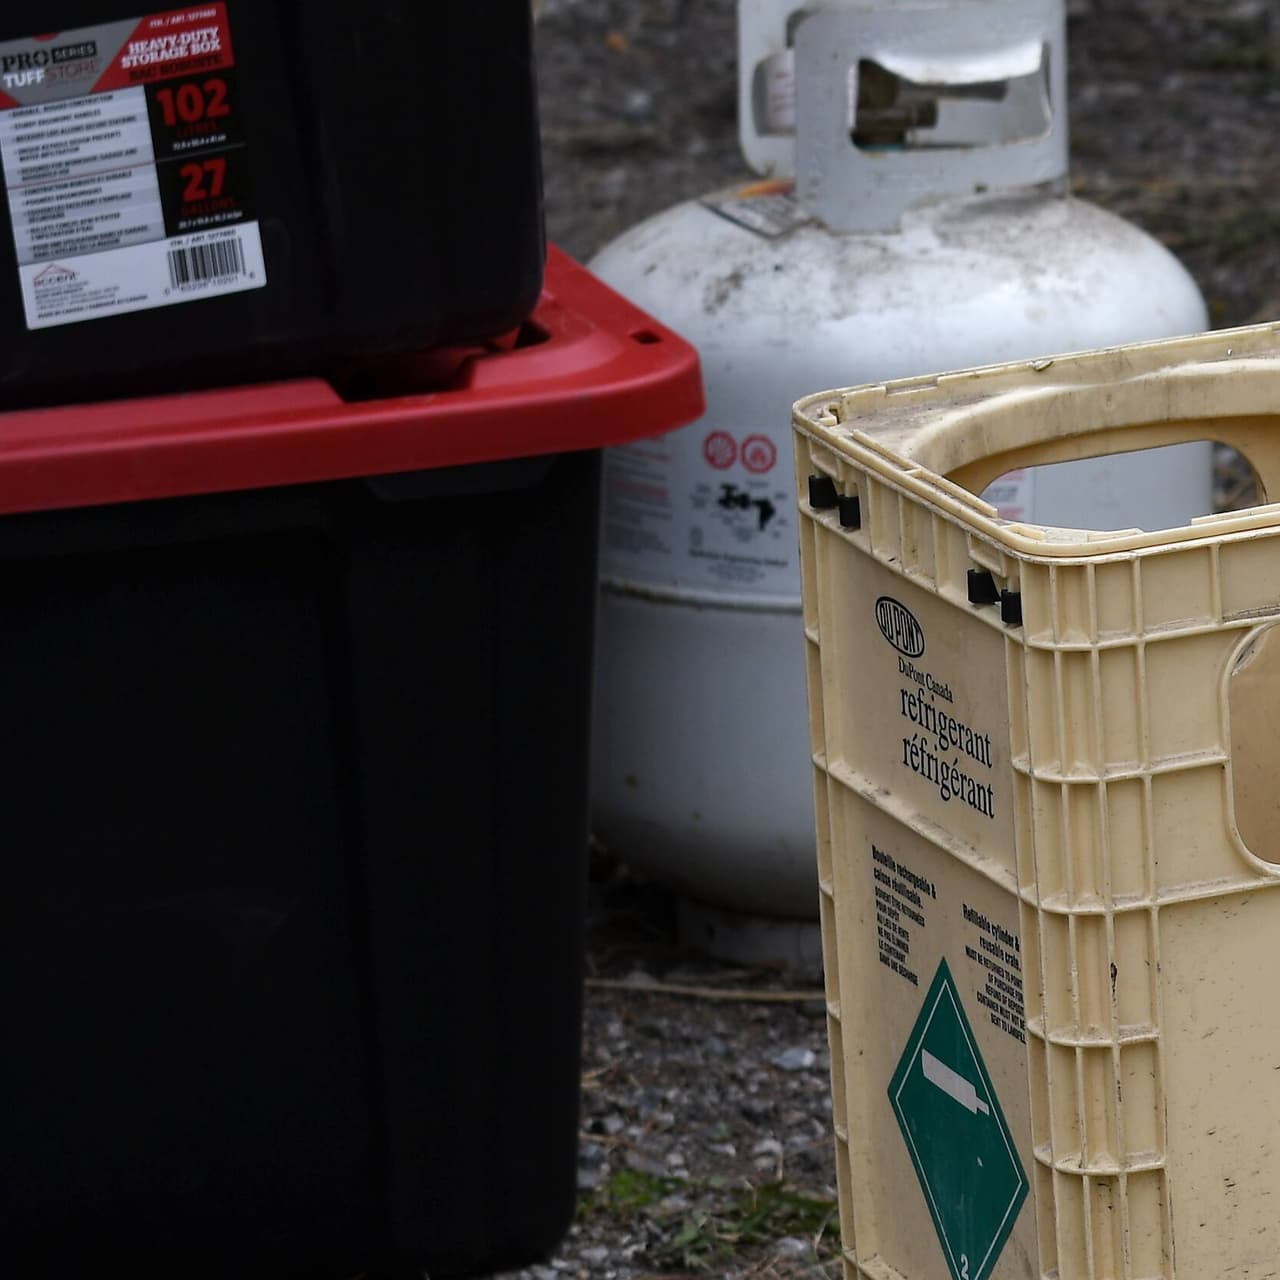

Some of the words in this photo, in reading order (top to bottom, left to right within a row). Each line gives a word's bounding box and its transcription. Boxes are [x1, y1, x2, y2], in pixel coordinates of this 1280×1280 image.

[1, 48, 49, 73] PRO
[53, 42, 96, 61] SERIES
[121, 46, 189, 69] STORAGE
[192, 38, 221, 54] BOX
[129, 26, 219, 55] HEAVY-DUTY
[3, 67, 46, 89] TUFF
[155, 77, 232, 127] 102
[178, 157, 227, 202] 27
[898, 656, 925, 687] DuPont
[926, 673, 953, 704] Canada
[901, 687, 993, 768] refrigerant
[903, 733, 995, 819] réfrigérant
[960, 1254, 969, 1280] 2
